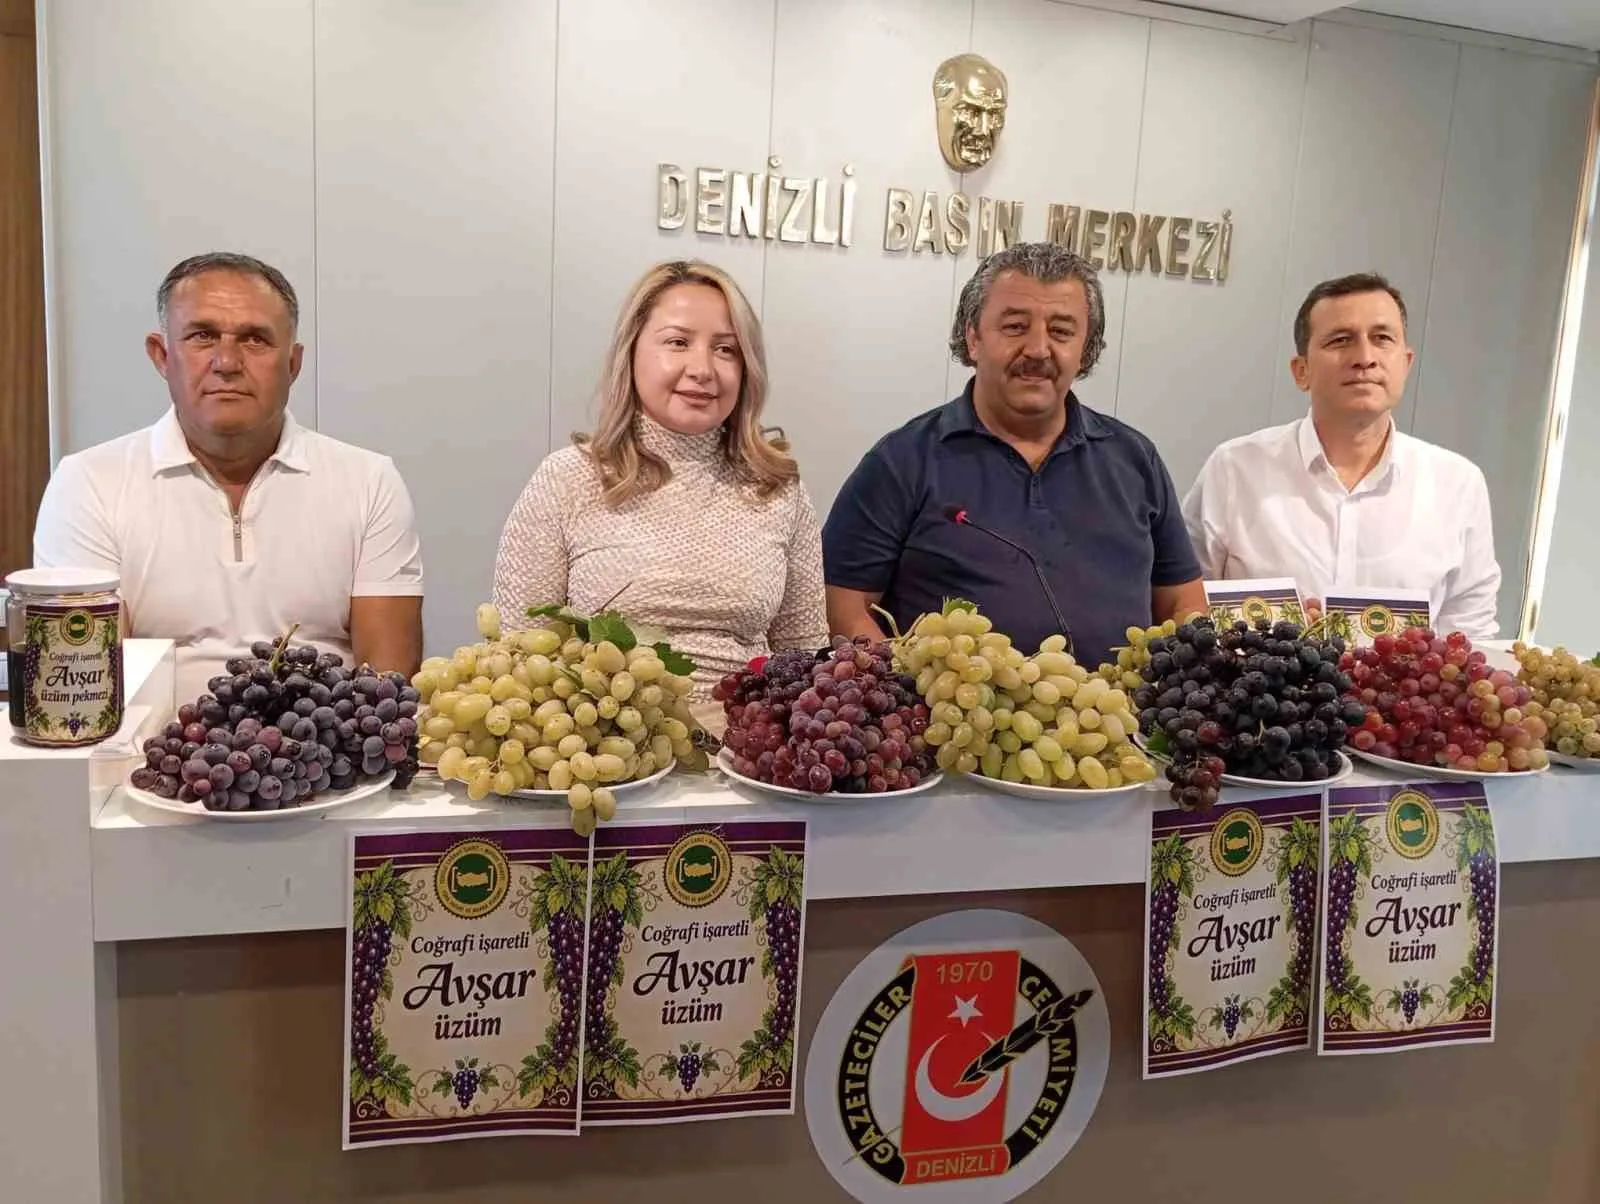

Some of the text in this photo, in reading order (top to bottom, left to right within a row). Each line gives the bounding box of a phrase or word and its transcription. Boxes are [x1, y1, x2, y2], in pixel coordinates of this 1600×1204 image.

[657, 154, 1234, 282] DENİZLİ BASIN MERKEZİ
[46, 666, 105, 688] Avşar
[41, 688, 108, 705] üzüm pekmezi
[1371, 869, 1457, 893] Coğrafi işaretli
[1193, 883, 1277, 912] Coğrafi işaretli
[1365, 896, 1462, 938] Avşar
[411, 931, 530, 957] Coğrafi işaretli
[641, 920, 750, 945] Coğrafi işaretli
[1187, 913, 1281, 958] Avşar
[1388, 941, 1436, 964] üzüm
[633, 949, 754, 996] Avşar
[936, 960, 994, 985] 1970
[1210, 955, 1257, 982] üzüm
[403, 962, 537, 1010] Avşar
[434, 1011, 502, 1041] üzüm
[661, 998, 723, 1025] üzüm
[1020, 975, 1077, 1145] CEMİYETİ
[844, 985, 912, 1165] GAZETECİLER
[916, 1150, 996, 1179] DENİZLİ
